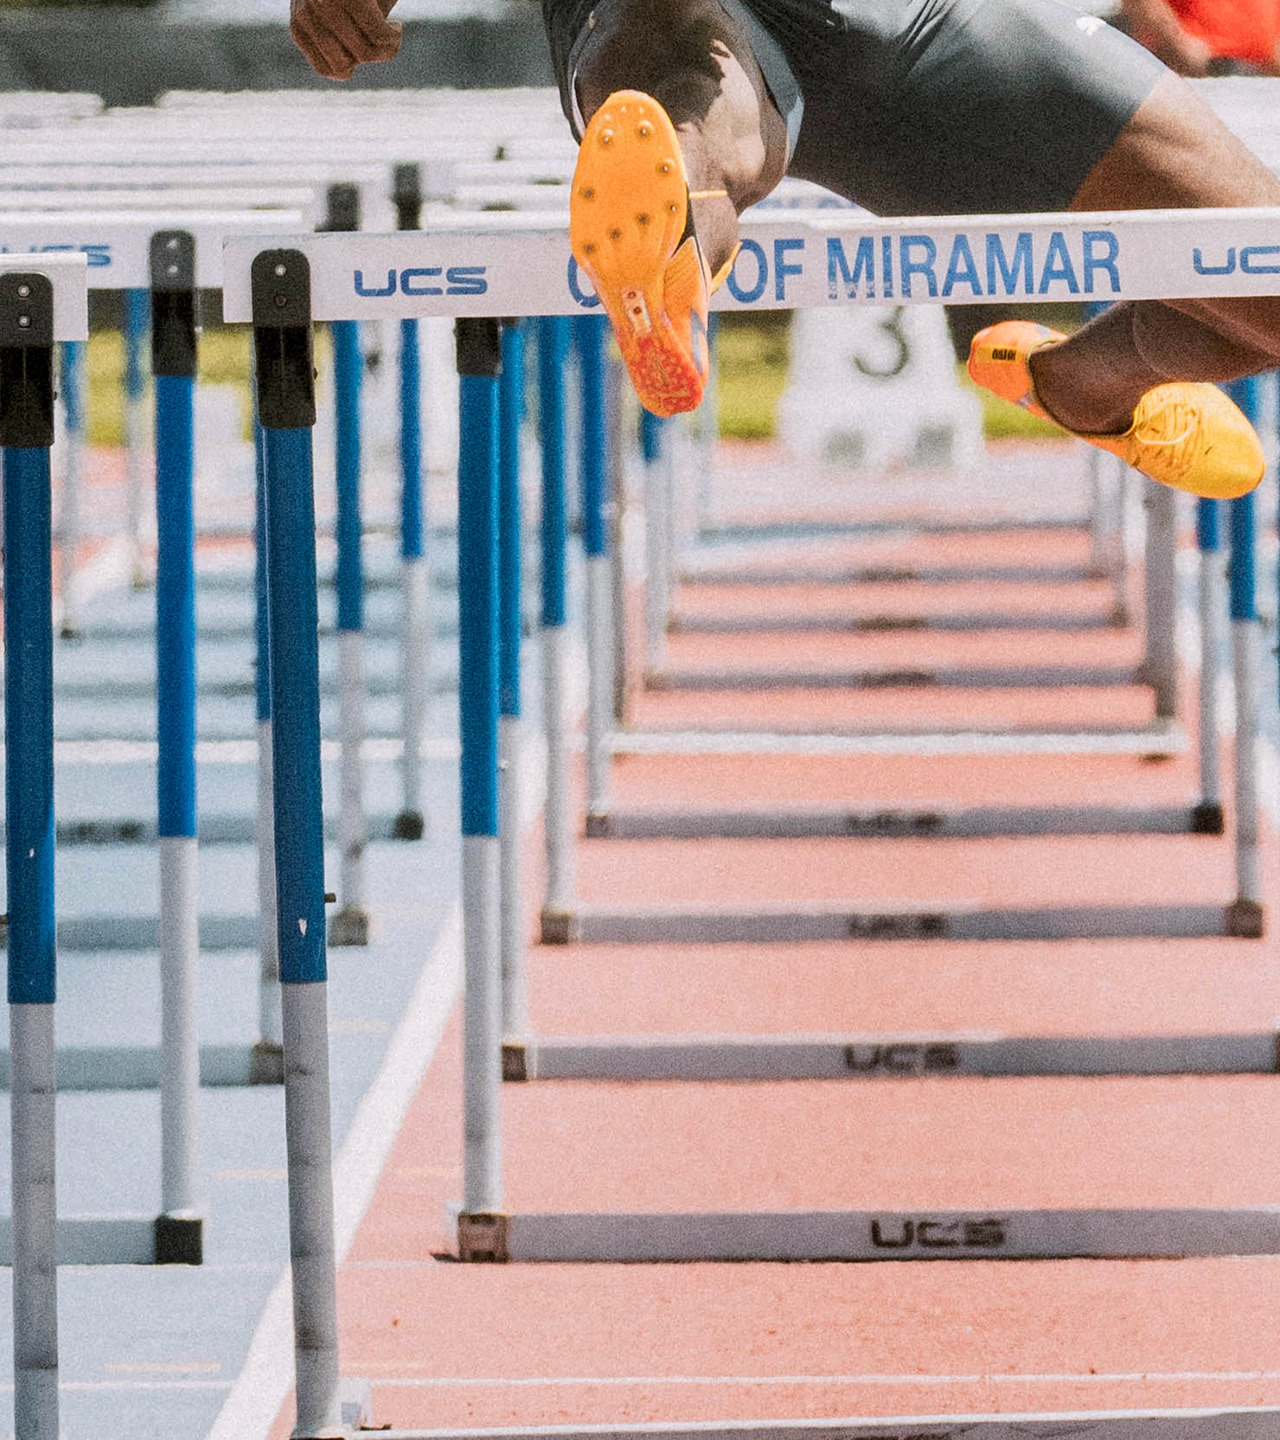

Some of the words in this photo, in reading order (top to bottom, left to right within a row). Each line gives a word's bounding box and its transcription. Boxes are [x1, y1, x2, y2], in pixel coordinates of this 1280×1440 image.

[353, 265, 488, 297] UCS
[726, 238, 805, 304] OF
[826, 230, 1121, 300] MIRAMAR
[869, 1218, 1006, 1250] UCS
